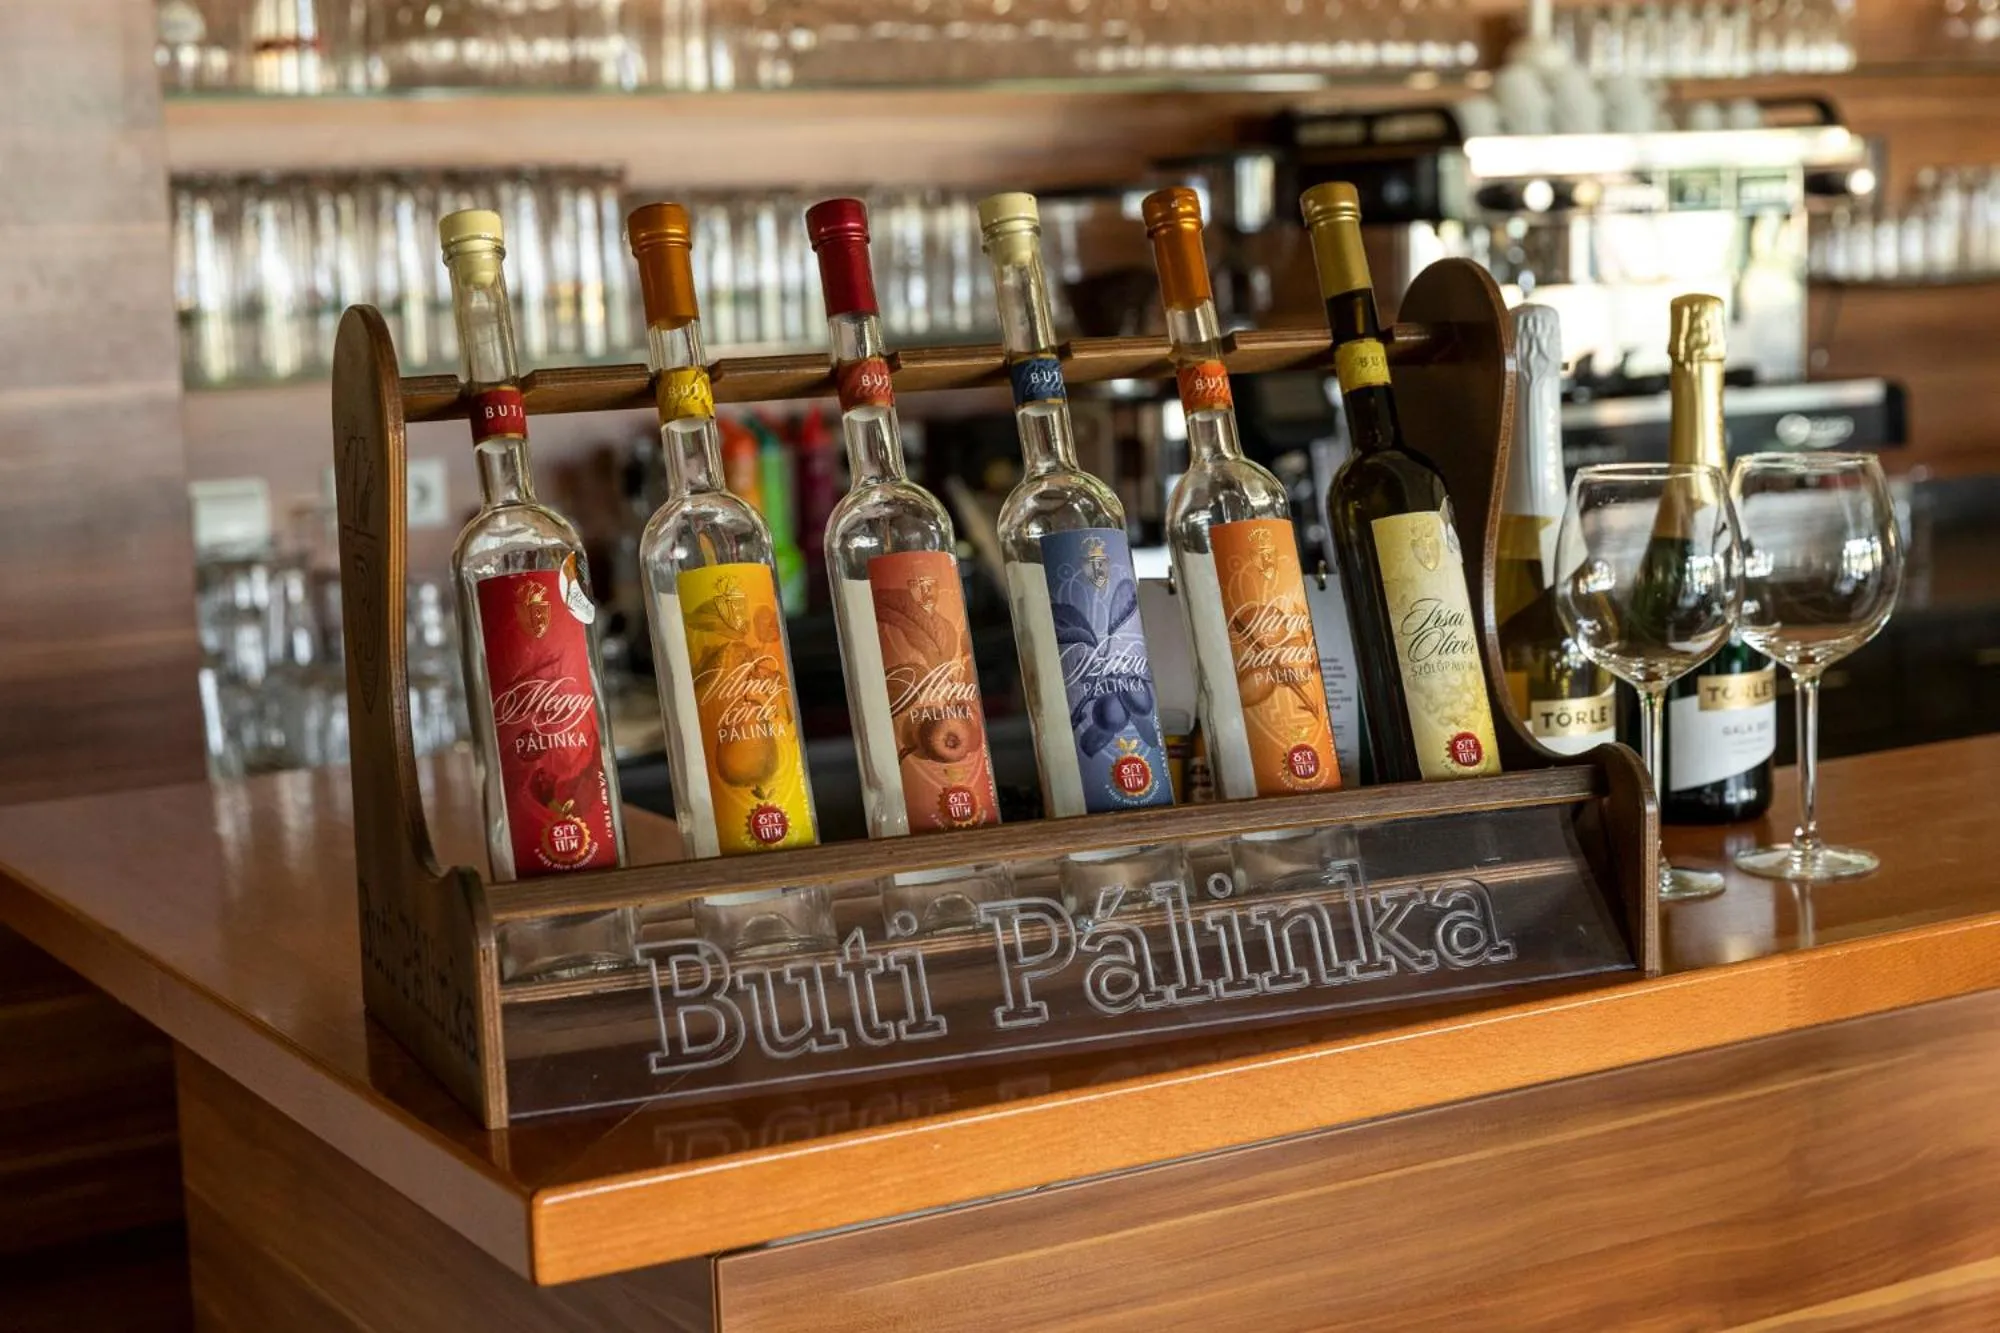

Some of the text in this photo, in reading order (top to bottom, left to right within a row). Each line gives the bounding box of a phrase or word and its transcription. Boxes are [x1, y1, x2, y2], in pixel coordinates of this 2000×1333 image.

[485, 404, 524, 419] BUTI
[493, 676, 594, 736] Meggy
[1541, 706, 1608, 729] TÖRLE
[515, 732, 588, 753] PÁLINKA
[634, 858, 1517, 1074] Buti Pálinka
